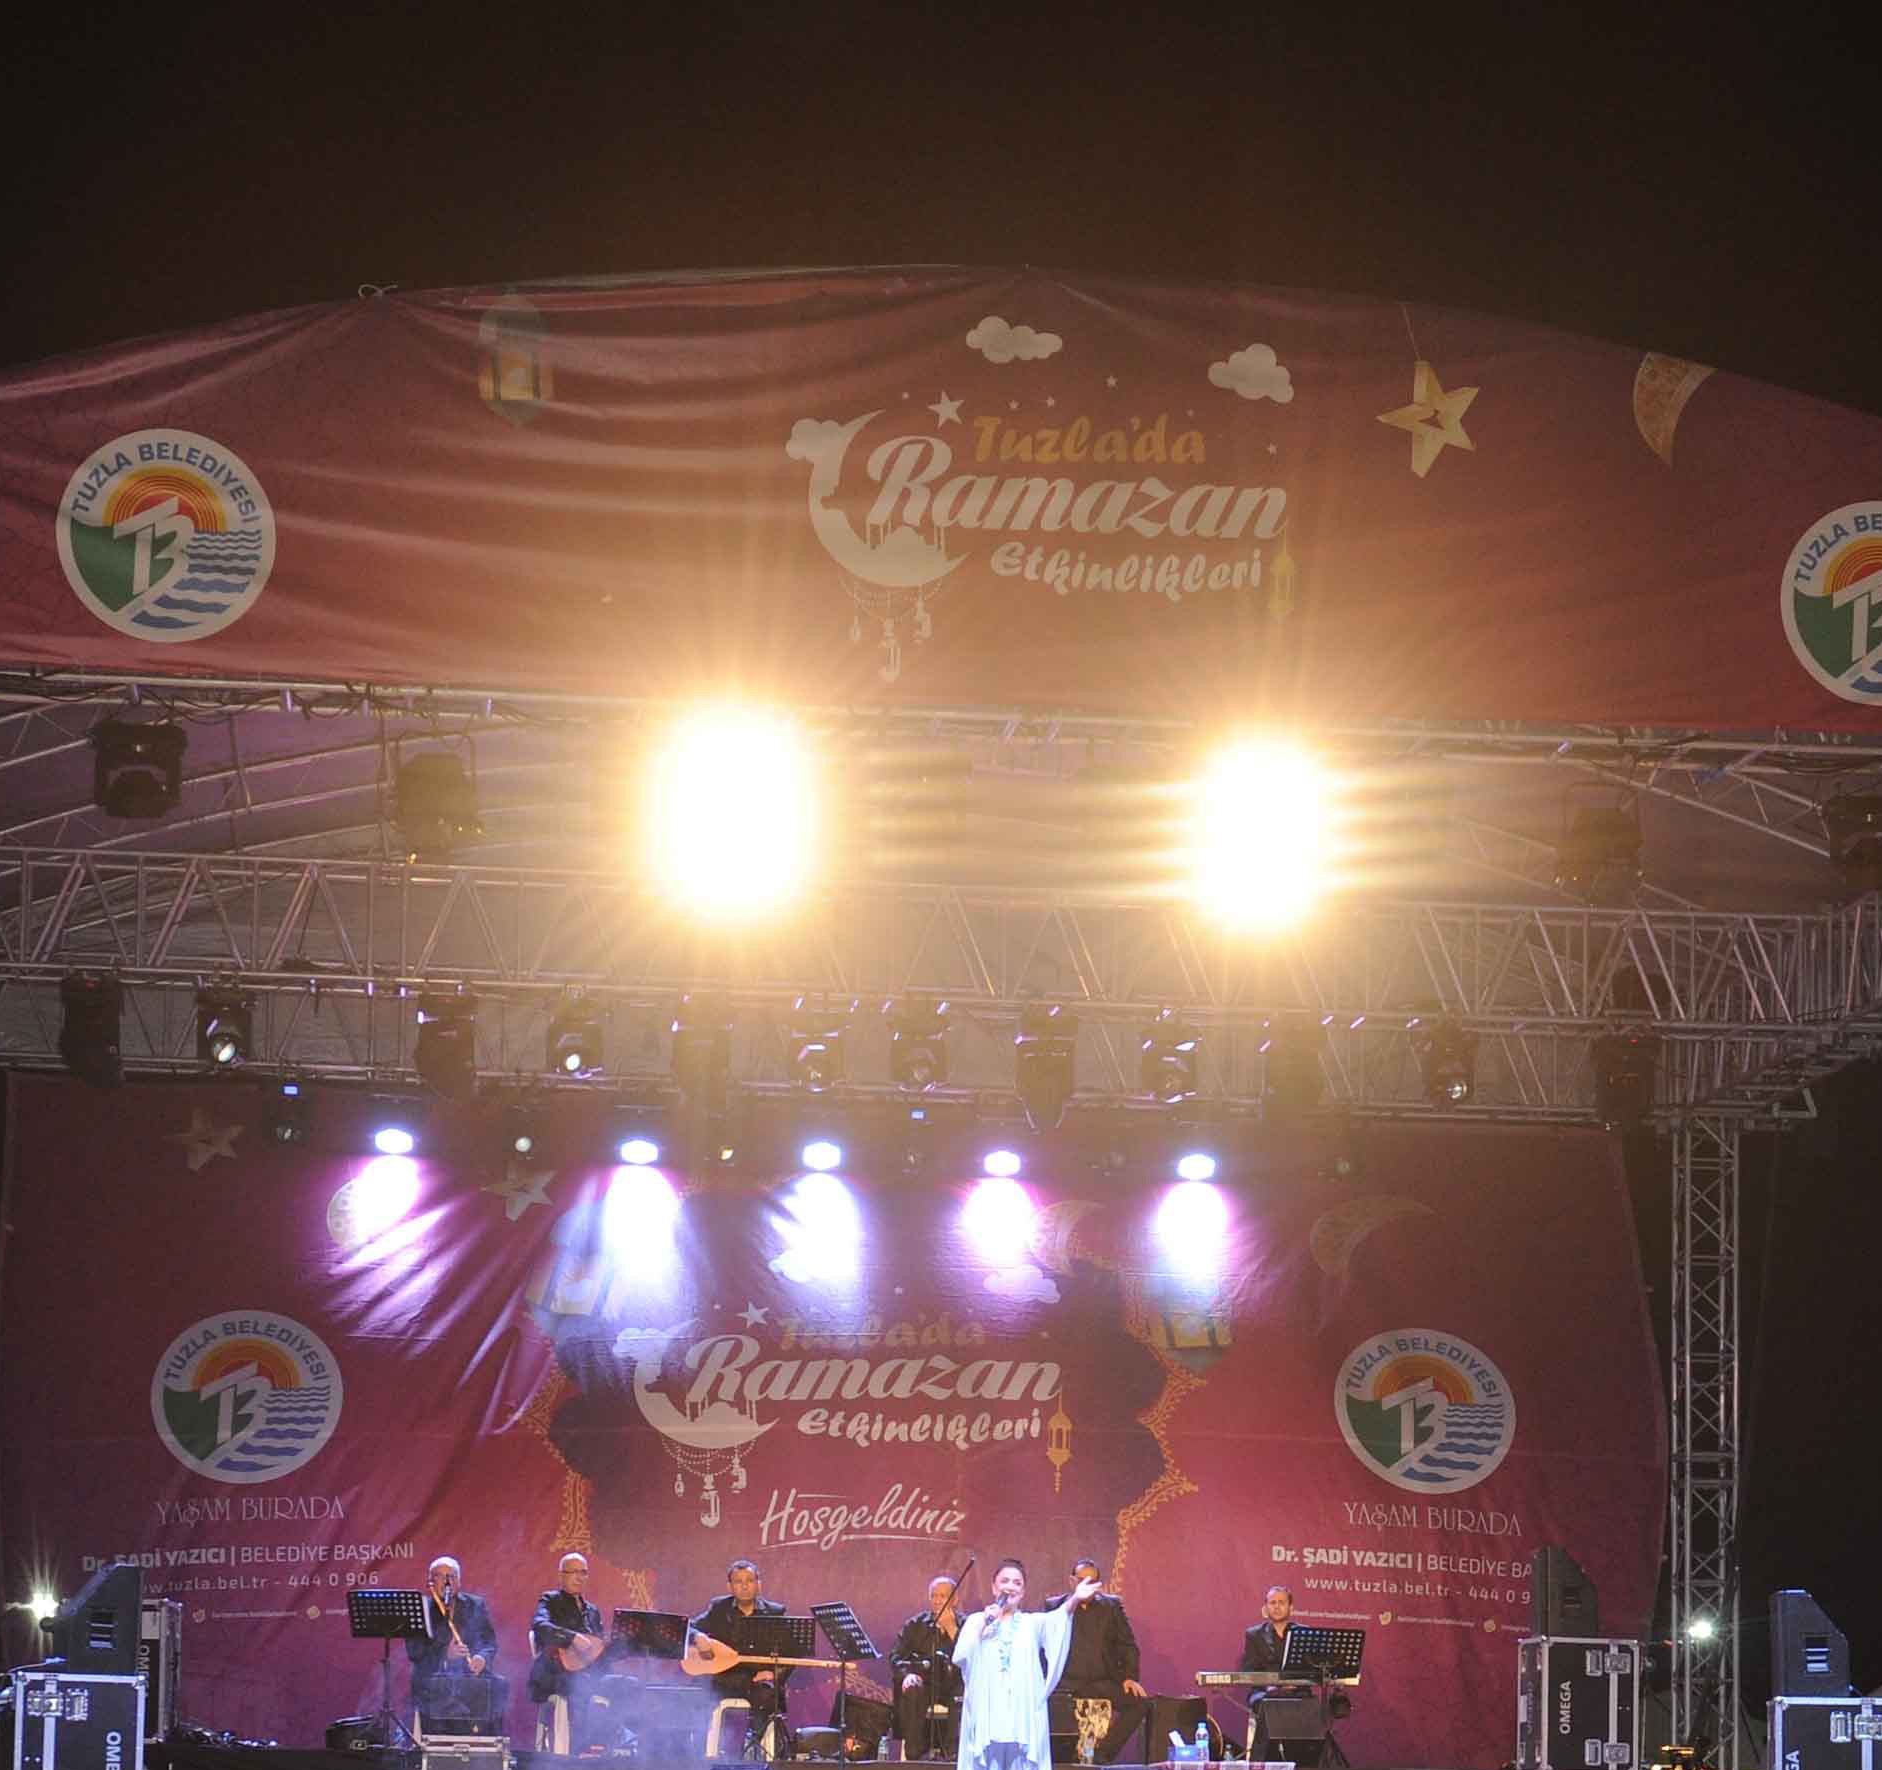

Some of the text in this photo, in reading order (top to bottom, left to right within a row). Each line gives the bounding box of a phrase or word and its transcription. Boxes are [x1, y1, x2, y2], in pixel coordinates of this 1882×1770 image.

[972, 414, 1207, 464] Tuzla'da
[70, 452, 133, 513] TUZLA
[866, 434, 1289, 540] Ramazan
[1794, 522, 1849, 582] TUZLA
[163, 1328, 217, 1381] TUZLA
[684, 1332, 1062, 1401] Ramazan
[1346, 1343, 1393, 1389] TUZLA
[156, 1495, 346, 1527] YAŞAM BURADA
[759, 1483, 968, 1552] Hoşgeldiniz
[1344, 1501, 1523, 1537] YAŞAM BURADA
[165, 1547, 226, 1567] YAZICI
[240, 1543, 328, 1564] BELEDİYE
[333, 1542, 414, 1565] BAŞKANI
[287, 1574, 321, 1588] 444
[329, 1573, 339, 1587] 0
[345, 1571, 379, 1586] 906
[1271, 1544, 1299, 1563] Dr.
[1303, 1544, 1349, 1569] ŞADİ
[1351, 1549, 1413, 1569] YAZICI
[1426, 1554, 1506, 1577] BELEDİYE
[1304, 1576, 1451, 1597] www.tuzla.bel.tr
[1469, 1587, 1500, 1601] 444
[1505, 1590, 1516, 1603] 0
[1558, 1680, 1572, 1735] OMEGA
